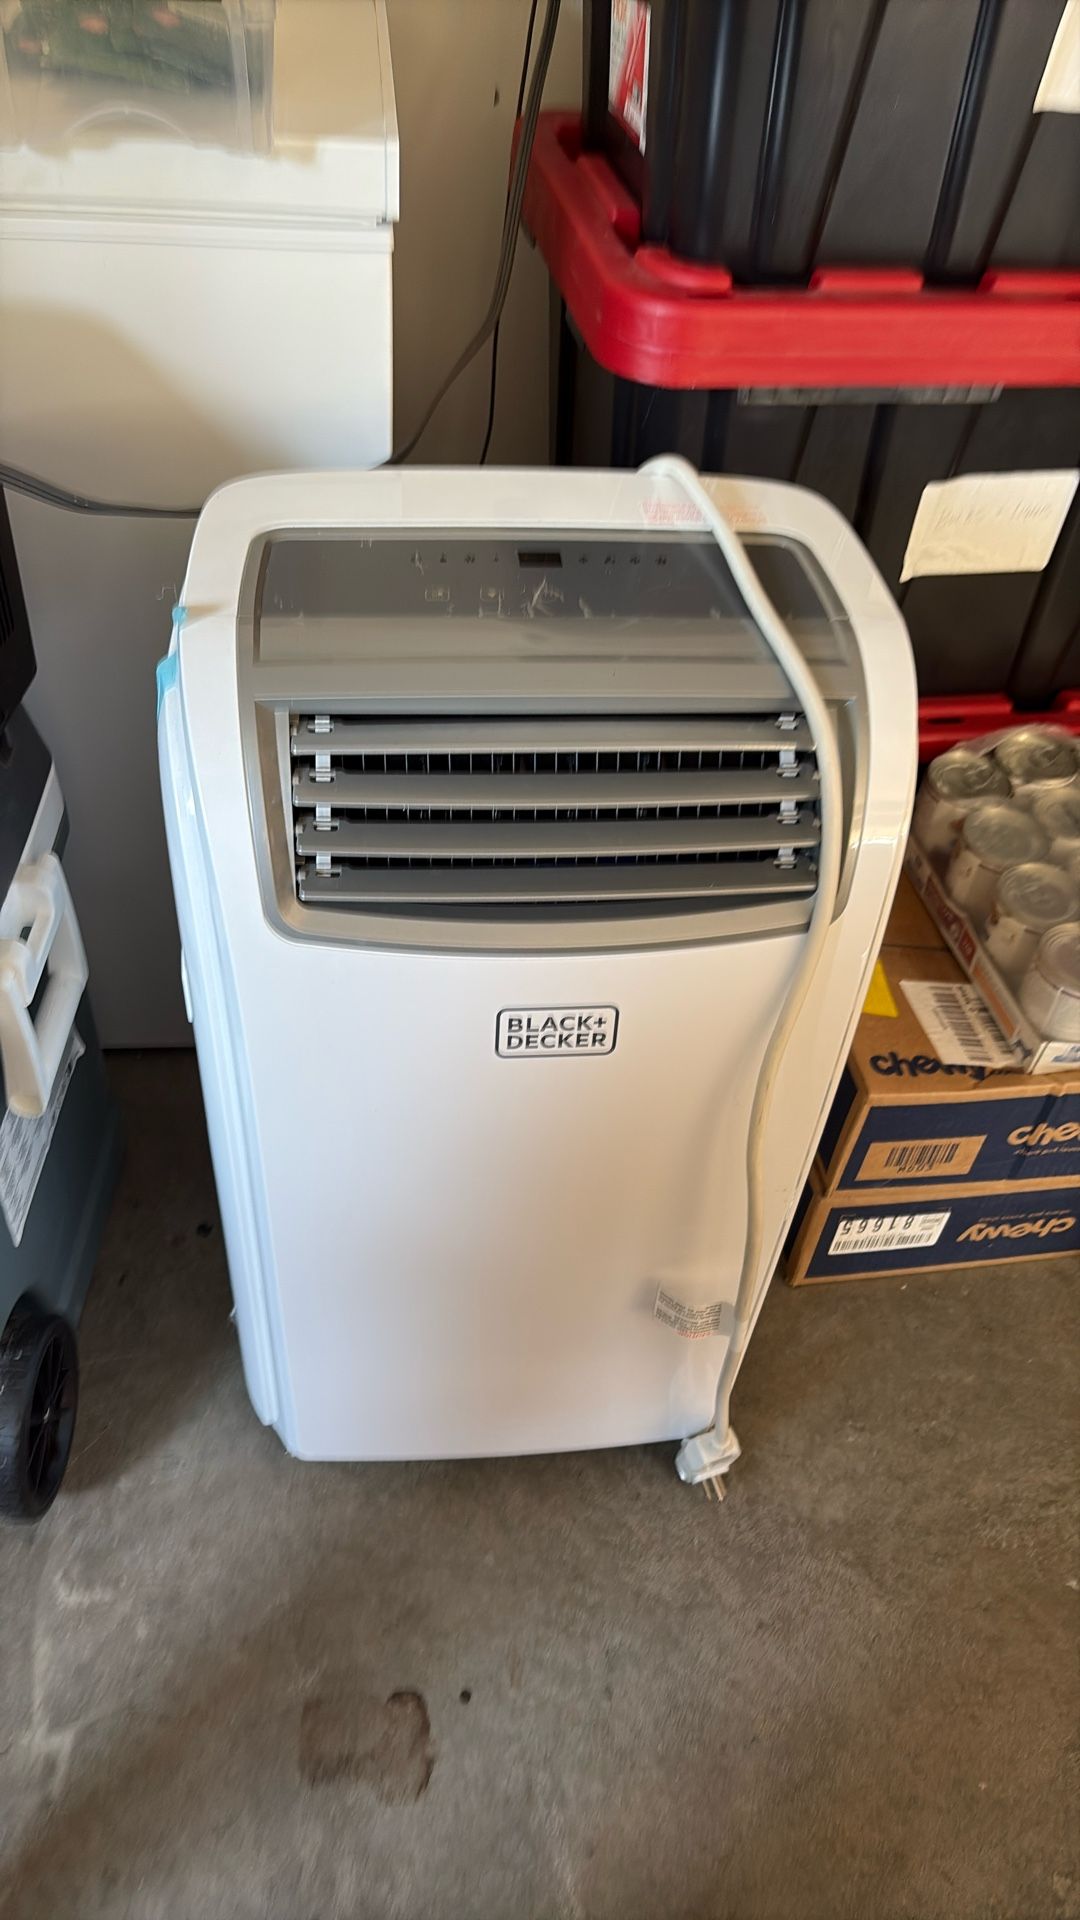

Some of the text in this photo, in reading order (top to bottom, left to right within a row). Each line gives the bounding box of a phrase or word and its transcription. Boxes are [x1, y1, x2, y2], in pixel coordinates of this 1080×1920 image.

[507, 1015, 607, 1033] BLACK+
[506, 1032, 607, 1050] DECKER
[1007, 1121, 1080, 1146] che
[841, 1214, 916, 1237] 81665
[955, 1217, 1077, 1243] chewy
